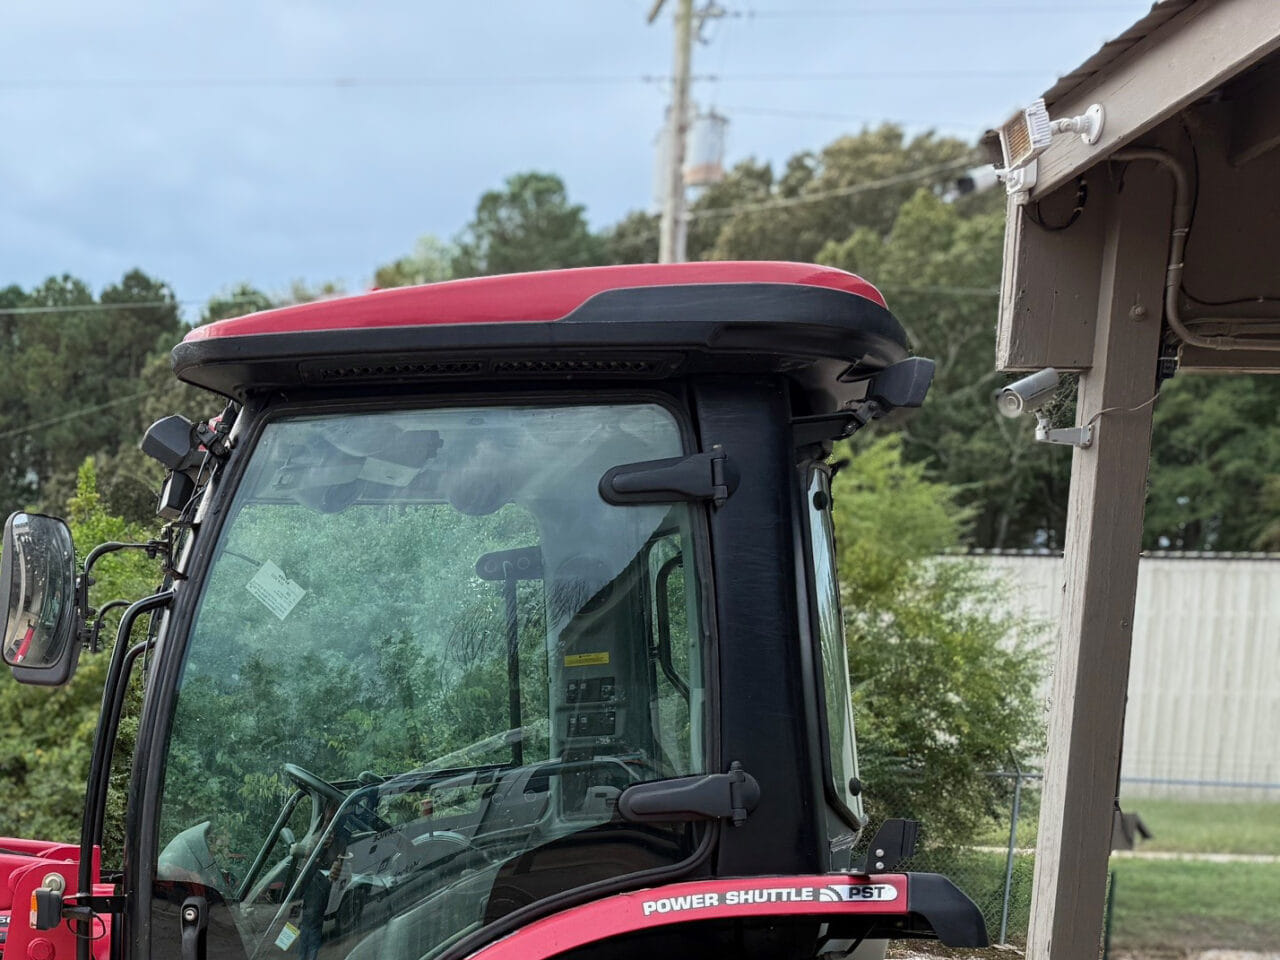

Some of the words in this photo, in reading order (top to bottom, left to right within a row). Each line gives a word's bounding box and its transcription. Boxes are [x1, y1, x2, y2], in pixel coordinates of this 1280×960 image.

[642, 892, 720, 916] POWER
[725, 887, 814, 906] SHUTTLE
[847, 886, 886, 900] PST
